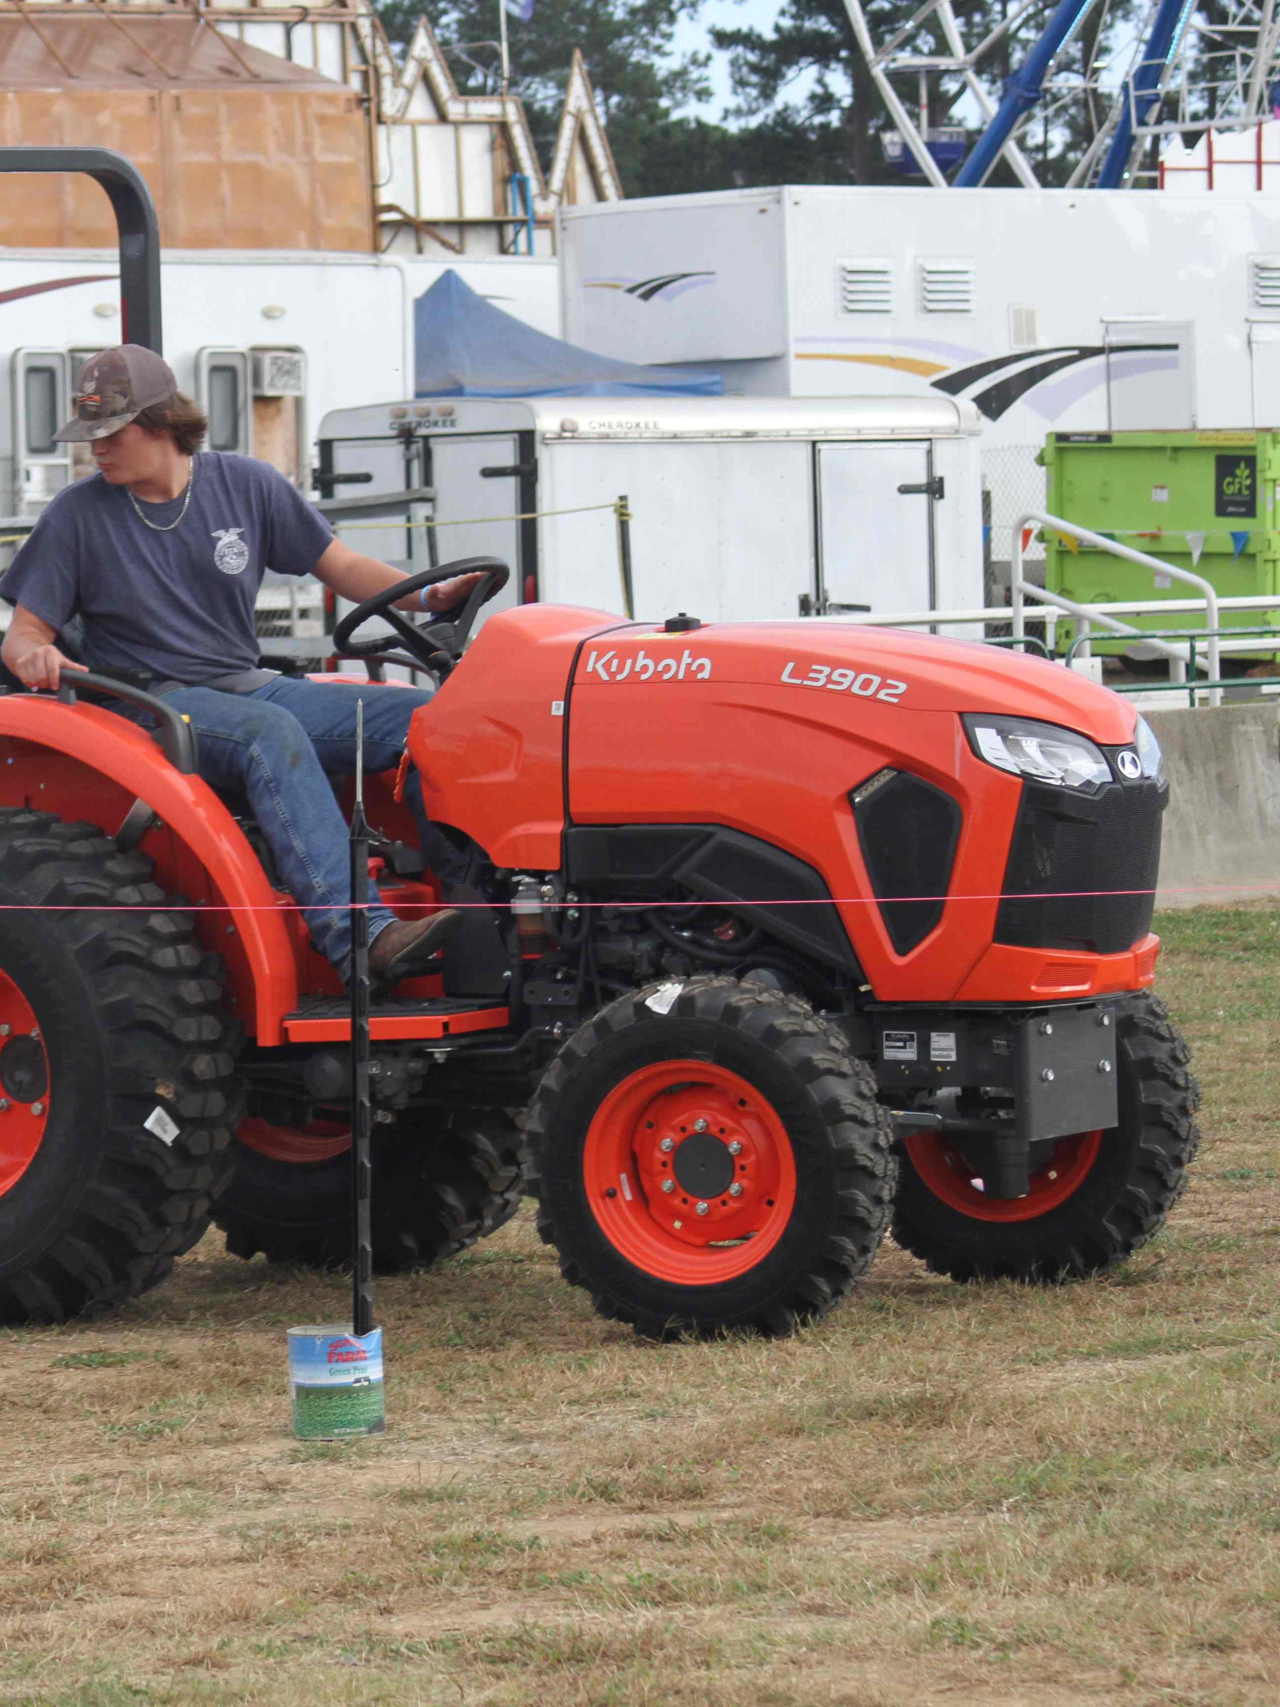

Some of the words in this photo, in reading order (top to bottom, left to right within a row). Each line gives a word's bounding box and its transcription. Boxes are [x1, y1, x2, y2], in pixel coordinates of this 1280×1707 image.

[389, 419, 457, 430] CHEROKEE
[589, 421, 660, 429] CHEROKEE
[586, 649, 712, 681] Kubota
[780, 661, 908, 703] L3902
[328, 1350, 368, 1363] FARM
[328, 1366, 352, 1377] Green
